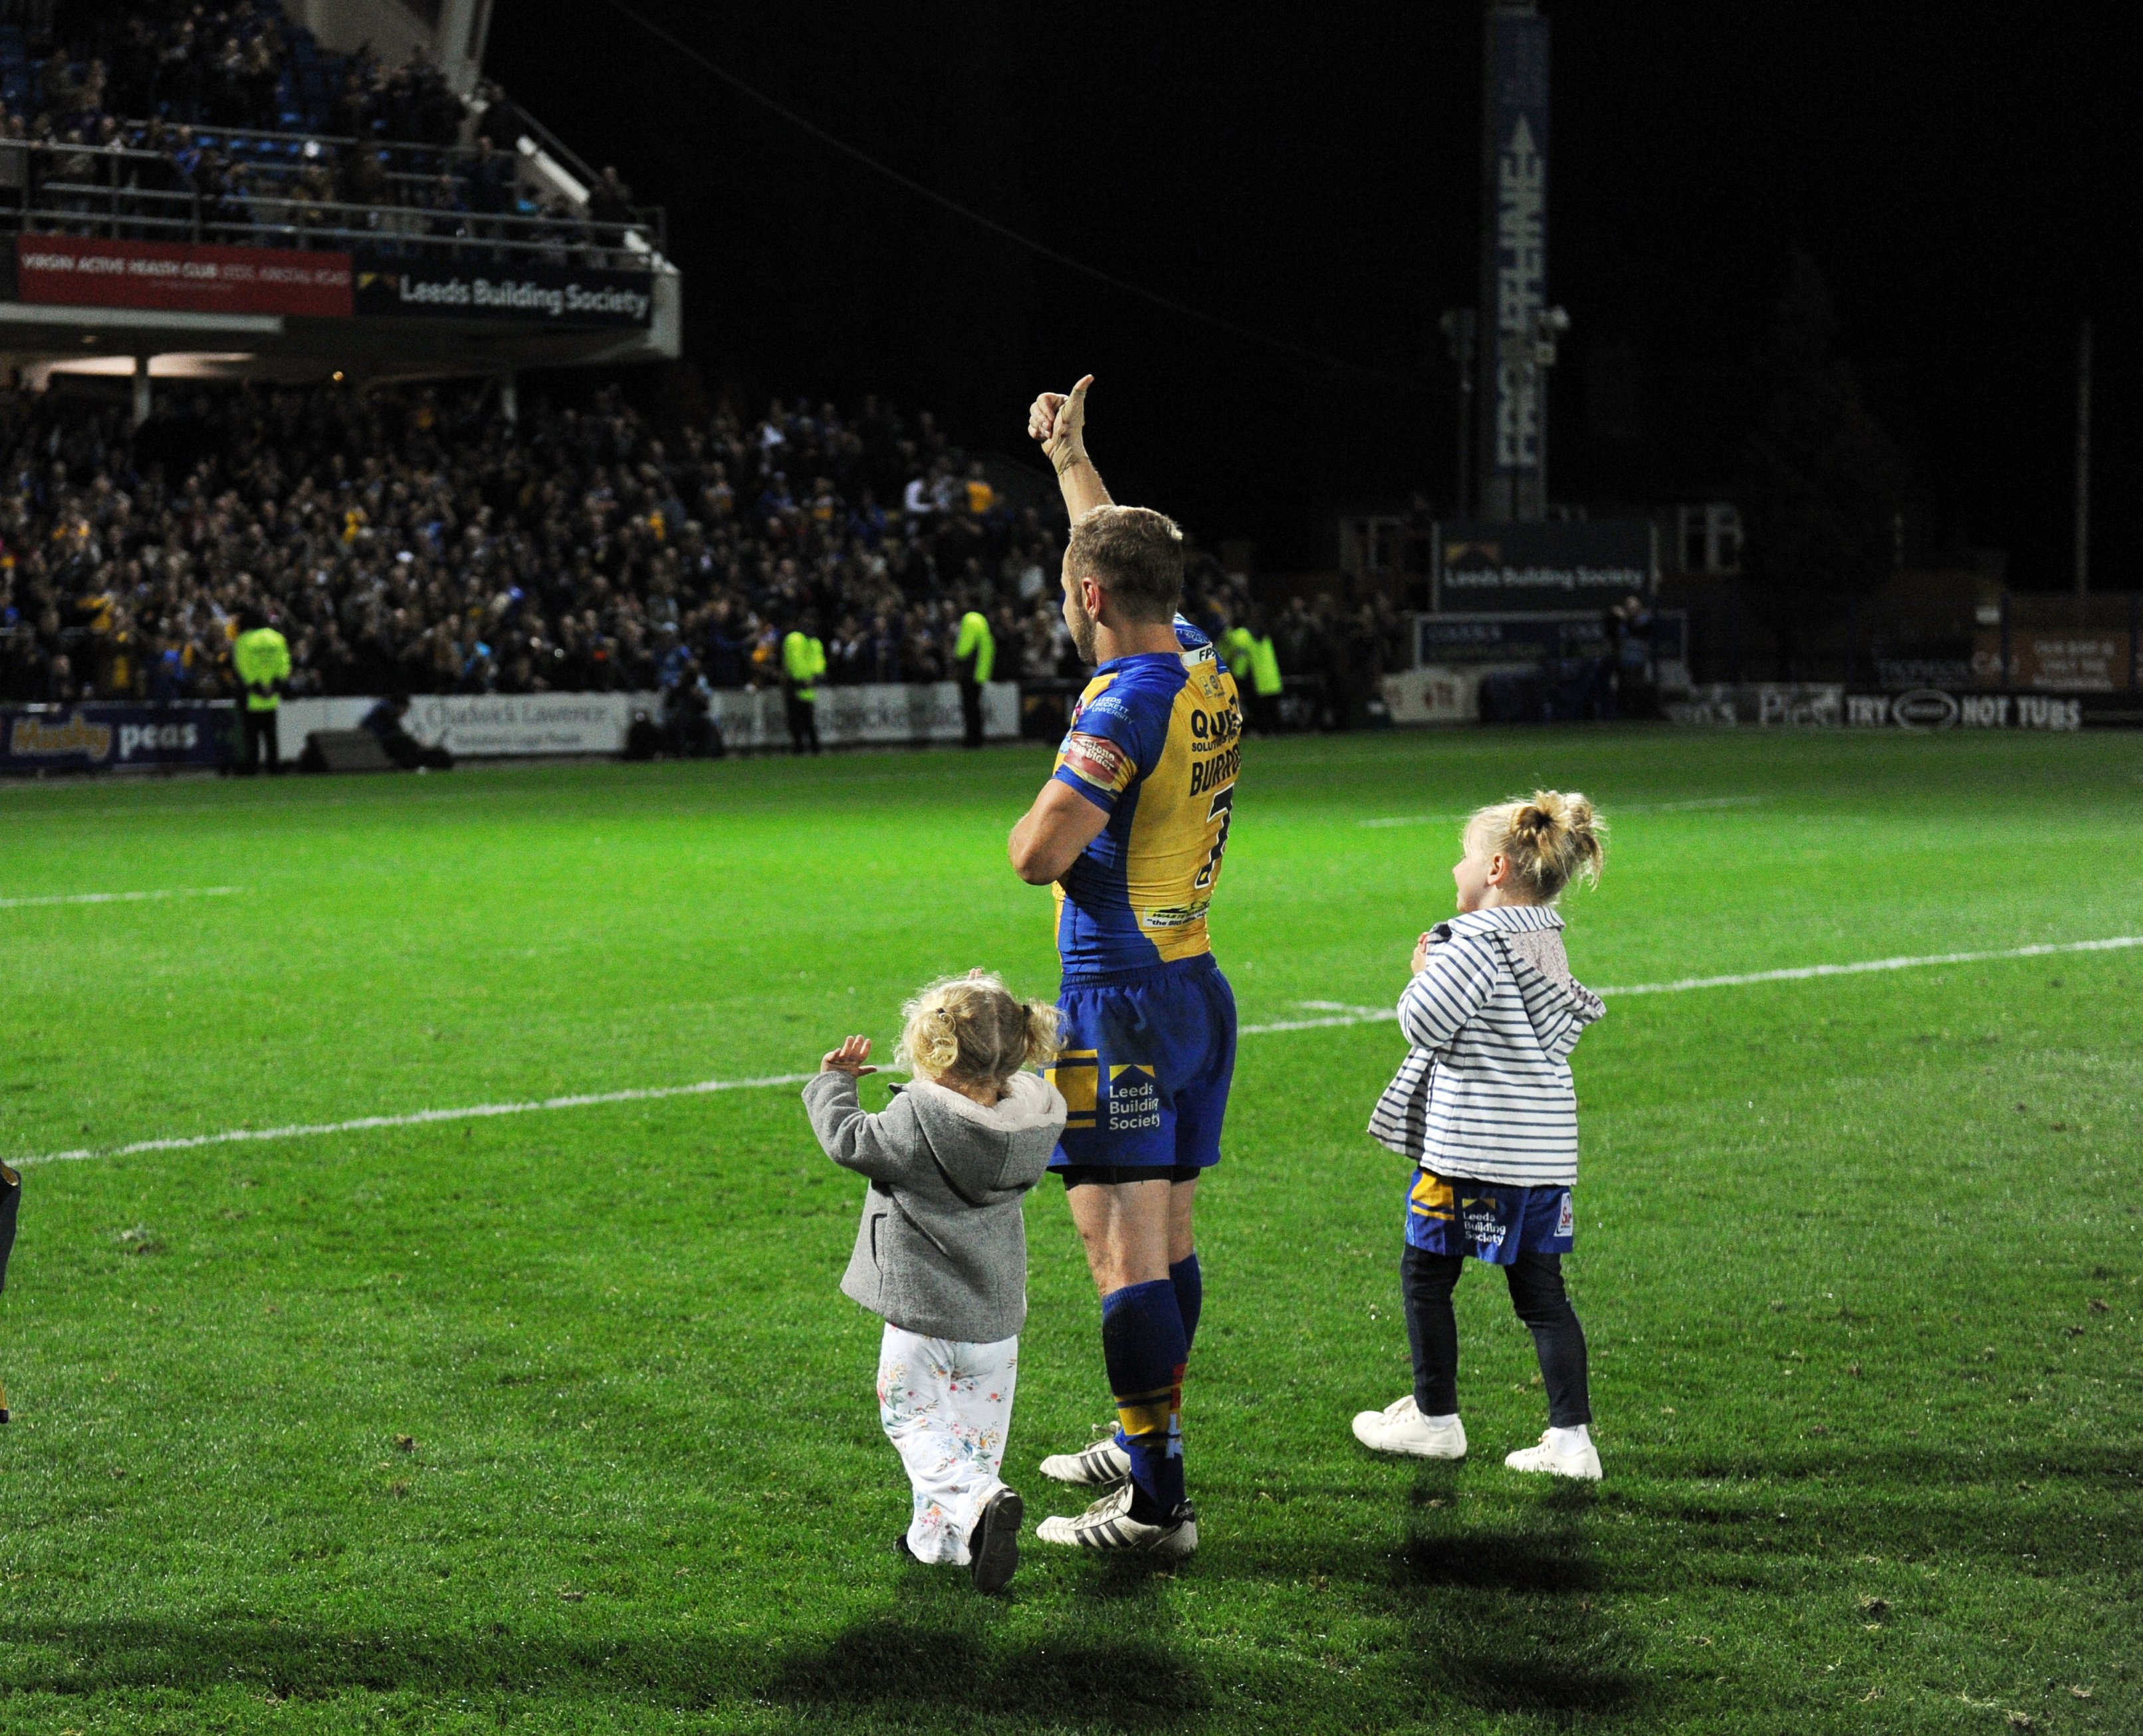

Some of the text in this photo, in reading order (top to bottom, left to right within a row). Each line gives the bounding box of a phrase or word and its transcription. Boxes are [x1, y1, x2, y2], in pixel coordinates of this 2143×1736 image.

[400, 274, 649, 320] Leeds Building Society
[1444, 566, 1644, 590] Leeds Building Society
[1092, 707, 1135, 724] UNIVERSITY
[1095, 701, 1129, 713] BECKETT
[1847, 695, 1891, 724] TRY
[2017, 695, 2081, 730] TUBS
[119, 723, 197, 760] peas
[1190, 743, 1240, 797] BURRO
[1194, 782, 1235, 889] 7
[1109, 1083, 1153, 1098] Leeds
[1109, 1113, 1160, 1130] Society
[1463, 1212, 1496, 1222] Leeds
[1464, 1221, 1506, 1236] Building
[1465, 1231, 1504, 1246] Society
